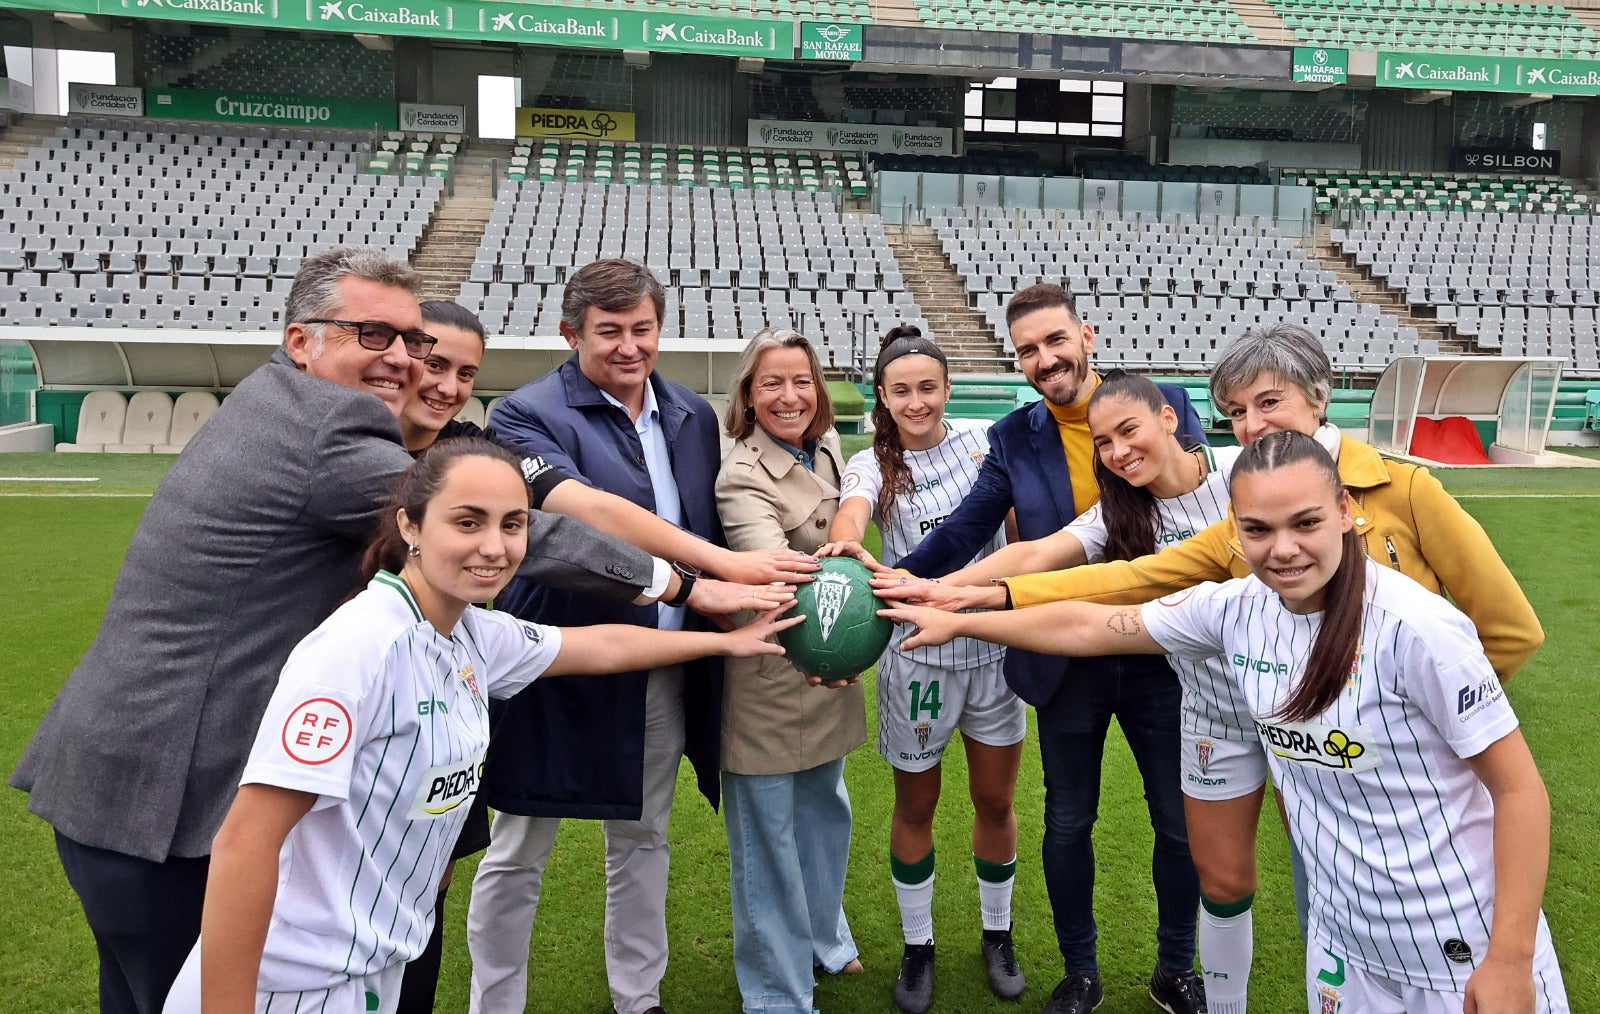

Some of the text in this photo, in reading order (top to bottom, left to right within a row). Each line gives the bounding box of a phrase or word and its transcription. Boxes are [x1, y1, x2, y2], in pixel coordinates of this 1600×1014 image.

[348, 4, 440, 26] CaixaBank
[518, 15, 606, 36] CaixaBank
[680, 26, 764, 47] CaixaBank
[803, 41, 861, 51] SAN RAFAEL
[815, 51, 850, 60] MOTOR
[1304, 74, 1334, 82] MOTOR
[1312, 66, 1344, 74] RAFAEL
[1417, 64, 1489, 81] CaixaBank
[1549, 69, 1600, 86] CaixaB
[215, 96, 330, 122] Cruzcampo
[1483, 155, 1552, 168] SILBON
[1233, 653, 1287, 676] GIVOVA
[908, 681, 943, 721] 14
[900, 746, 946, 760] GIVOVA
[1188, 774, 1226, 785] GIVOVA
